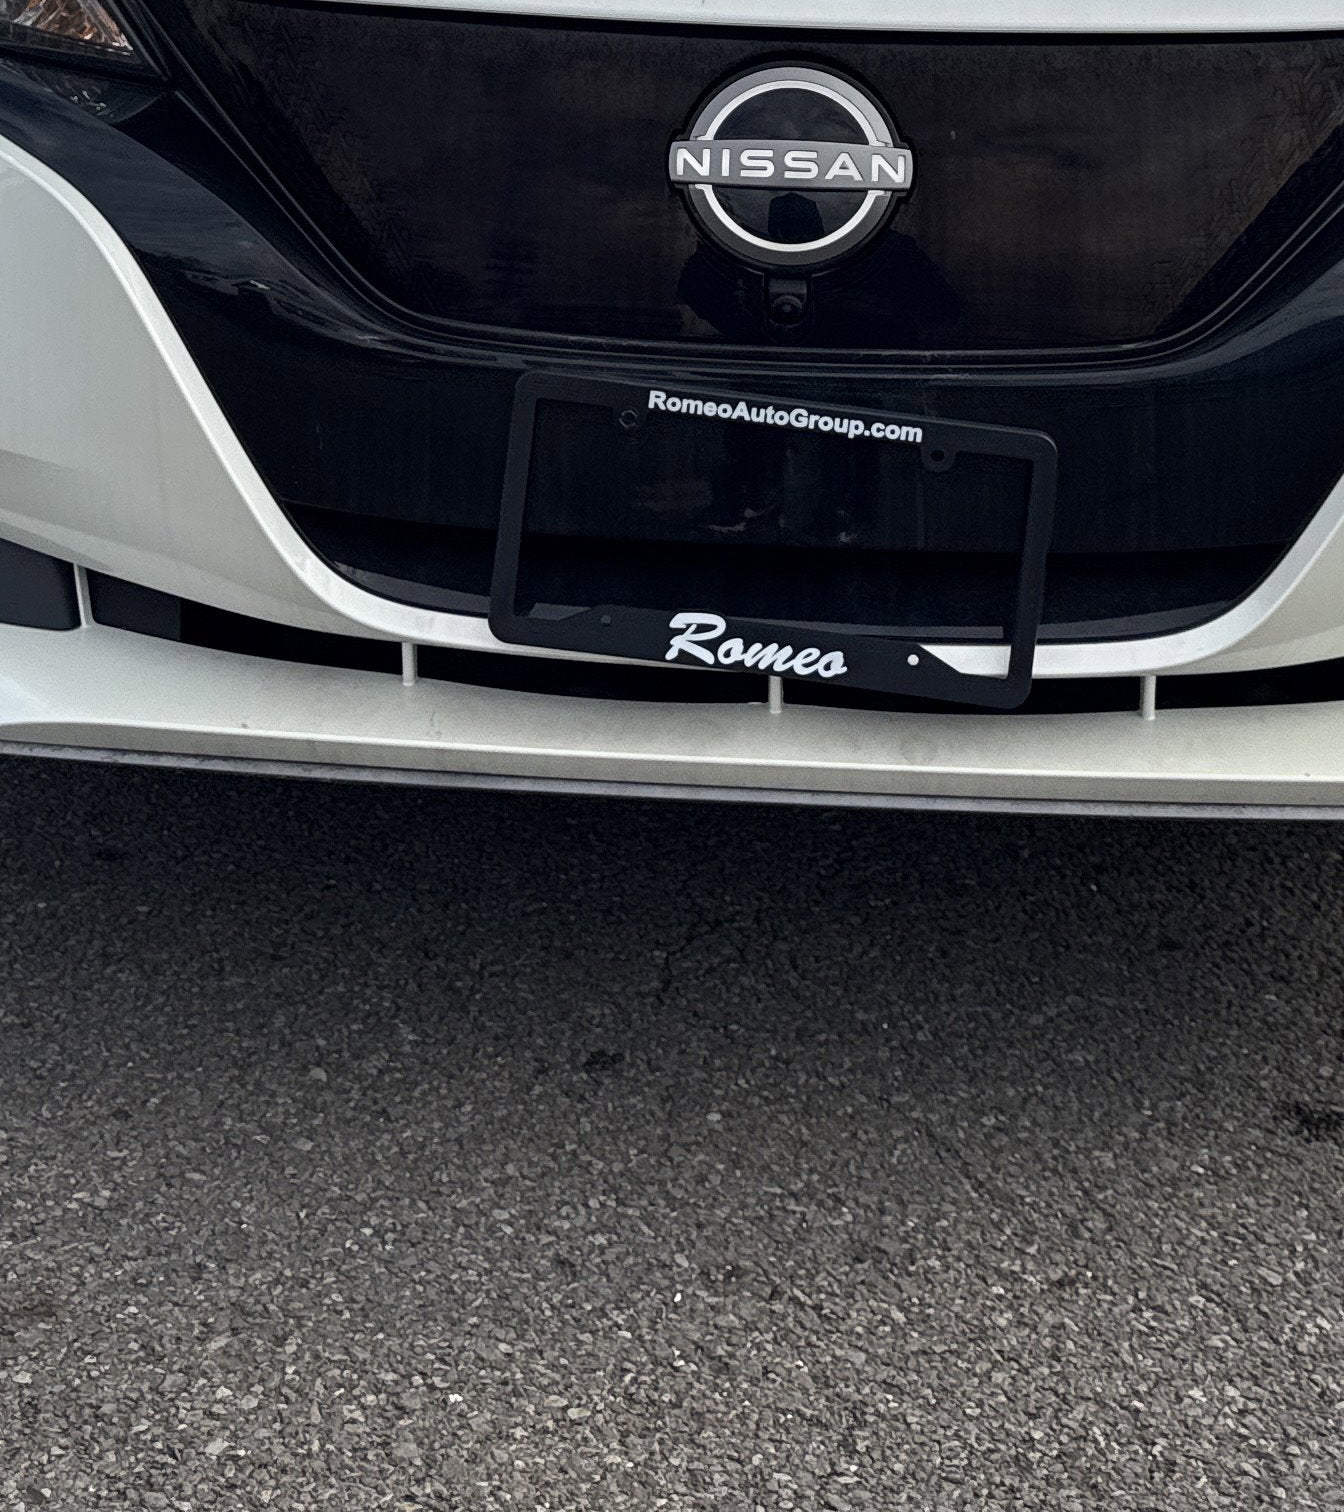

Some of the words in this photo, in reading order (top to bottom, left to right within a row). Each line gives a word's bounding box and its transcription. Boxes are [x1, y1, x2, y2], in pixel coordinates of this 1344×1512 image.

[676, 148, 905, 183] NISSAN
[648, 390, 923, 443] RomeoAutoGroup.com
[665, 612, 847, 678] Romeo
